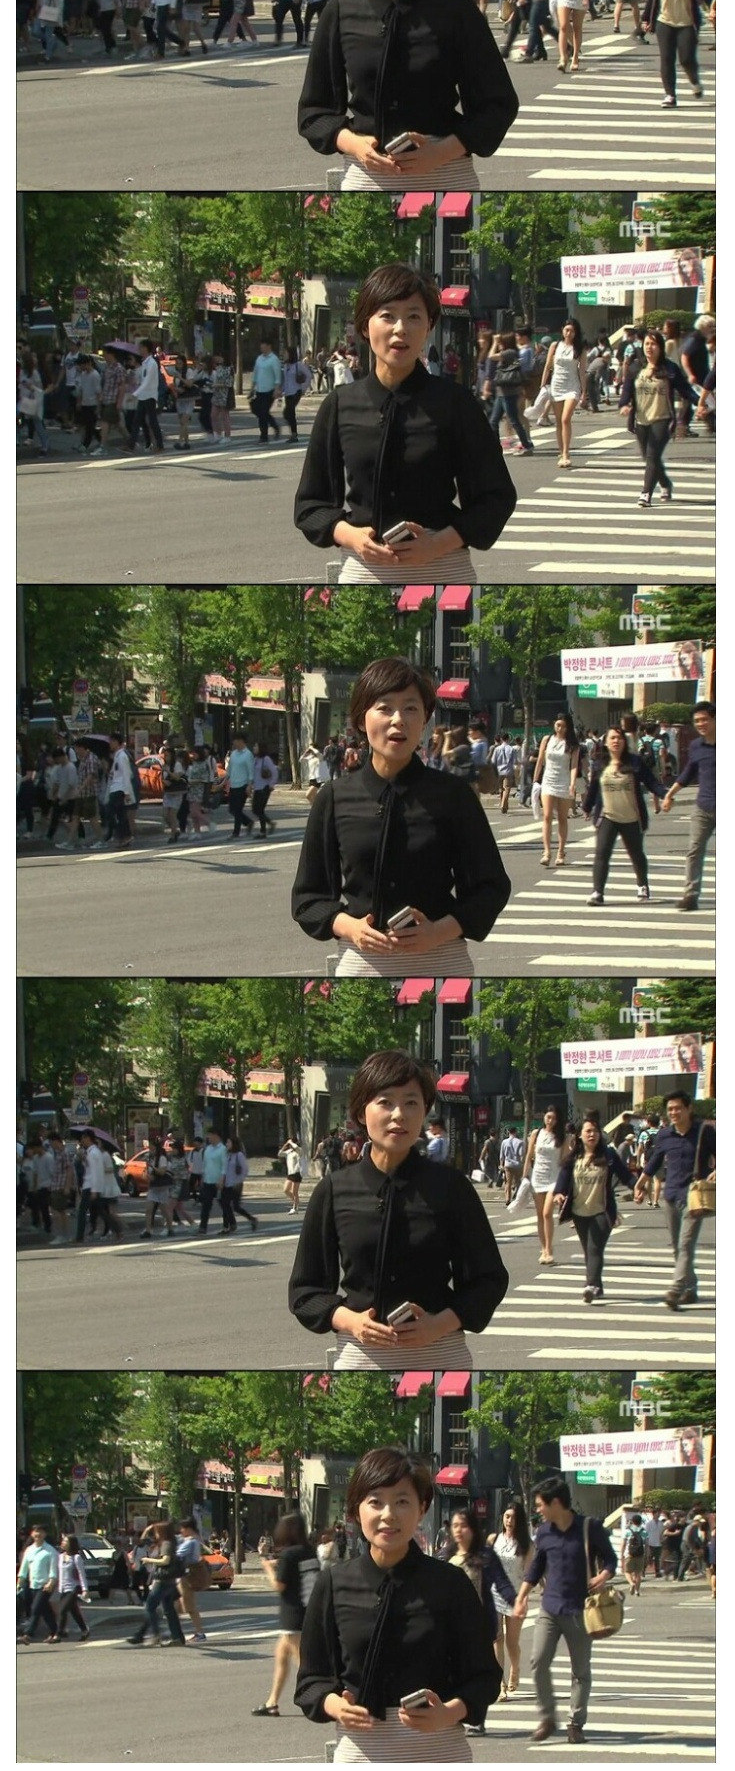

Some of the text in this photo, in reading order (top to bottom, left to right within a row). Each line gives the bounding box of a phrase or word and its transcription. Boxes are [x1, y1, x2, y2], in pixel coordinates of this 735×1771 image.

[564, 264, 612, 278] 박정현 콘서트
[564, 657, 612, 671] 박정현 콘서트
[564, 1050, 612, 1064] 박정현 콘서트
[562, 1443, 614, 1457] 박정현 콘서트
